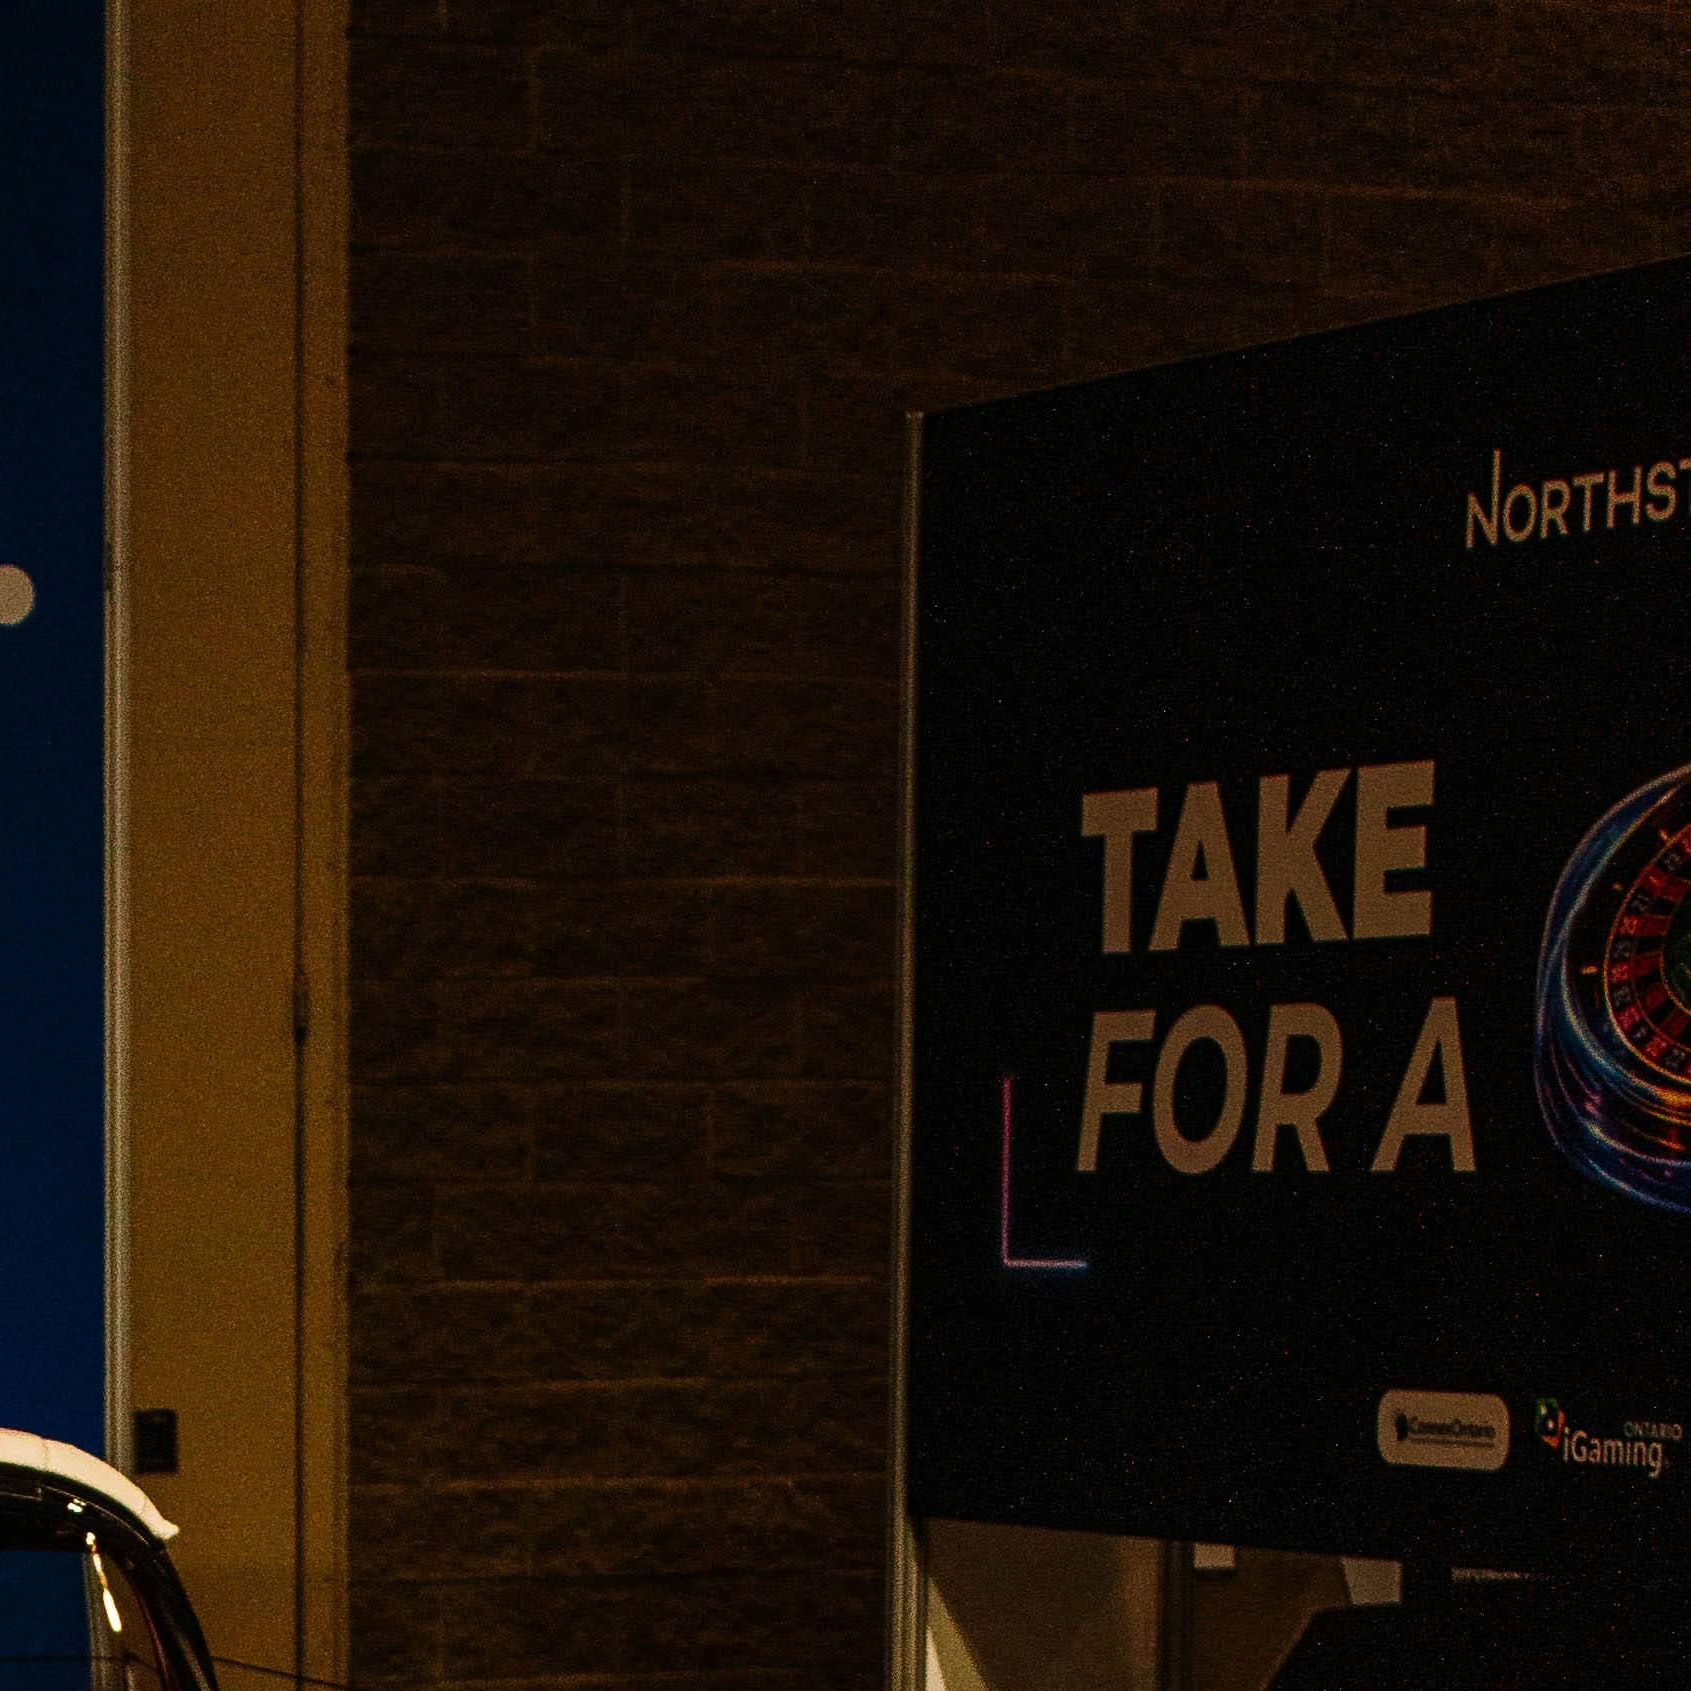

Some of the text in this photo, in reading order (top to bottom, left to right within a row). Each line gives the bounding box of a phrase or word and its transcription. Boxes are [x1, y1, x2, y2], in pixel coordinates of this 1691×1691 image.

[1081, 759, 1435, 954] TAKE
[1076, 997, 1476, 1174] FOR A
[1562, 1426, 1665, 1479] iGaming
